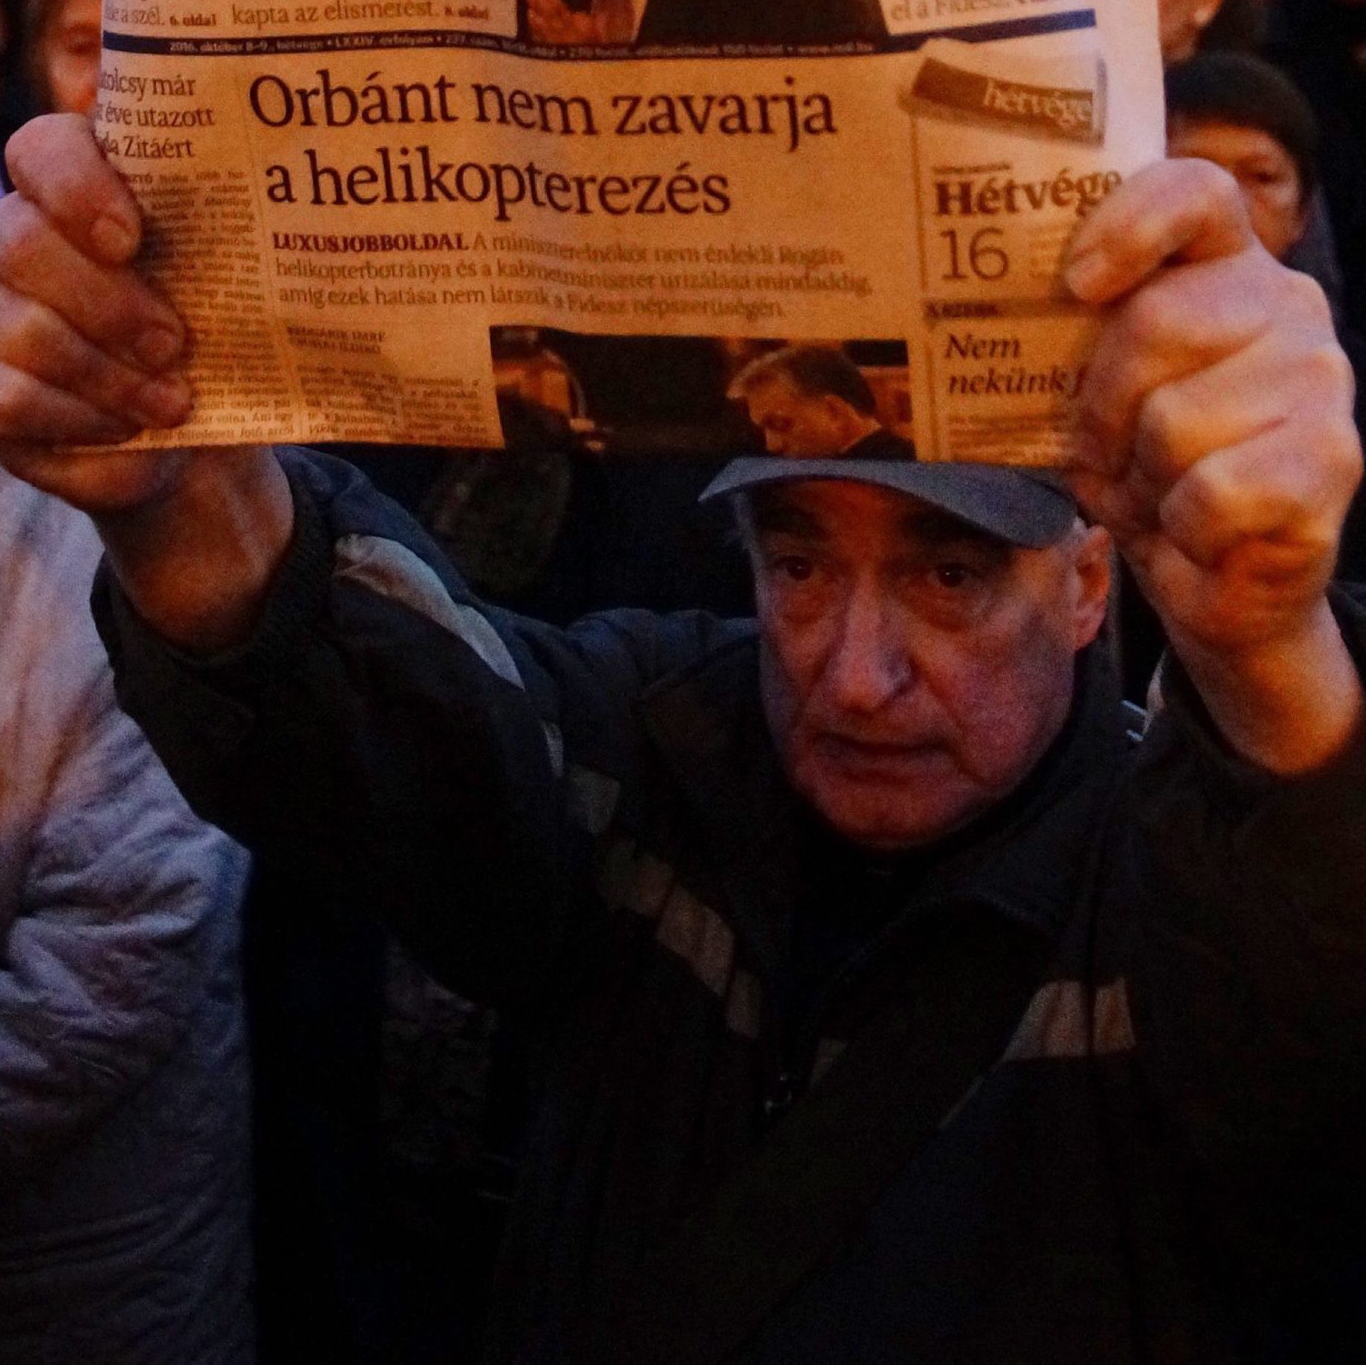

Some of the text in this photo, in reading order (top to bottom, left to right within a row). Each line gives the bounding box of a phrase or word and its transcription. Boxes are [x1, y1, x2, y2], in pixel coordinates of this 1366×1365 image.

[231, 3, 290, 31] kapta
[294, 5, 319, 23] az
[98, 68, 196, 103] tolcsy már
[105, 100, 132, 126] éve
[136, 106, 216, 128] utazott
[248, 70, 838, 153] Orbánt nem zavarja
[123, 135, 196, 159] Zitáért
[266, 146, 734, 222] a helikopterezés
[271, 231, 469, 254] LUXUSJOBBOLDAL
[471, 232, 487, 251] A
[939, 226, 1009, 281] 16
[275, 257, 452, 284] helikopterbotránya
[456, 259, 477, 278] és
[327, 285, 370, 306] ezek
[374, 286, 437, 306] hatása
[441, 289, 485, 305] nem
[944, 334, 1020, 360] Nem
[948, 367, 1068, 395] nekünk
